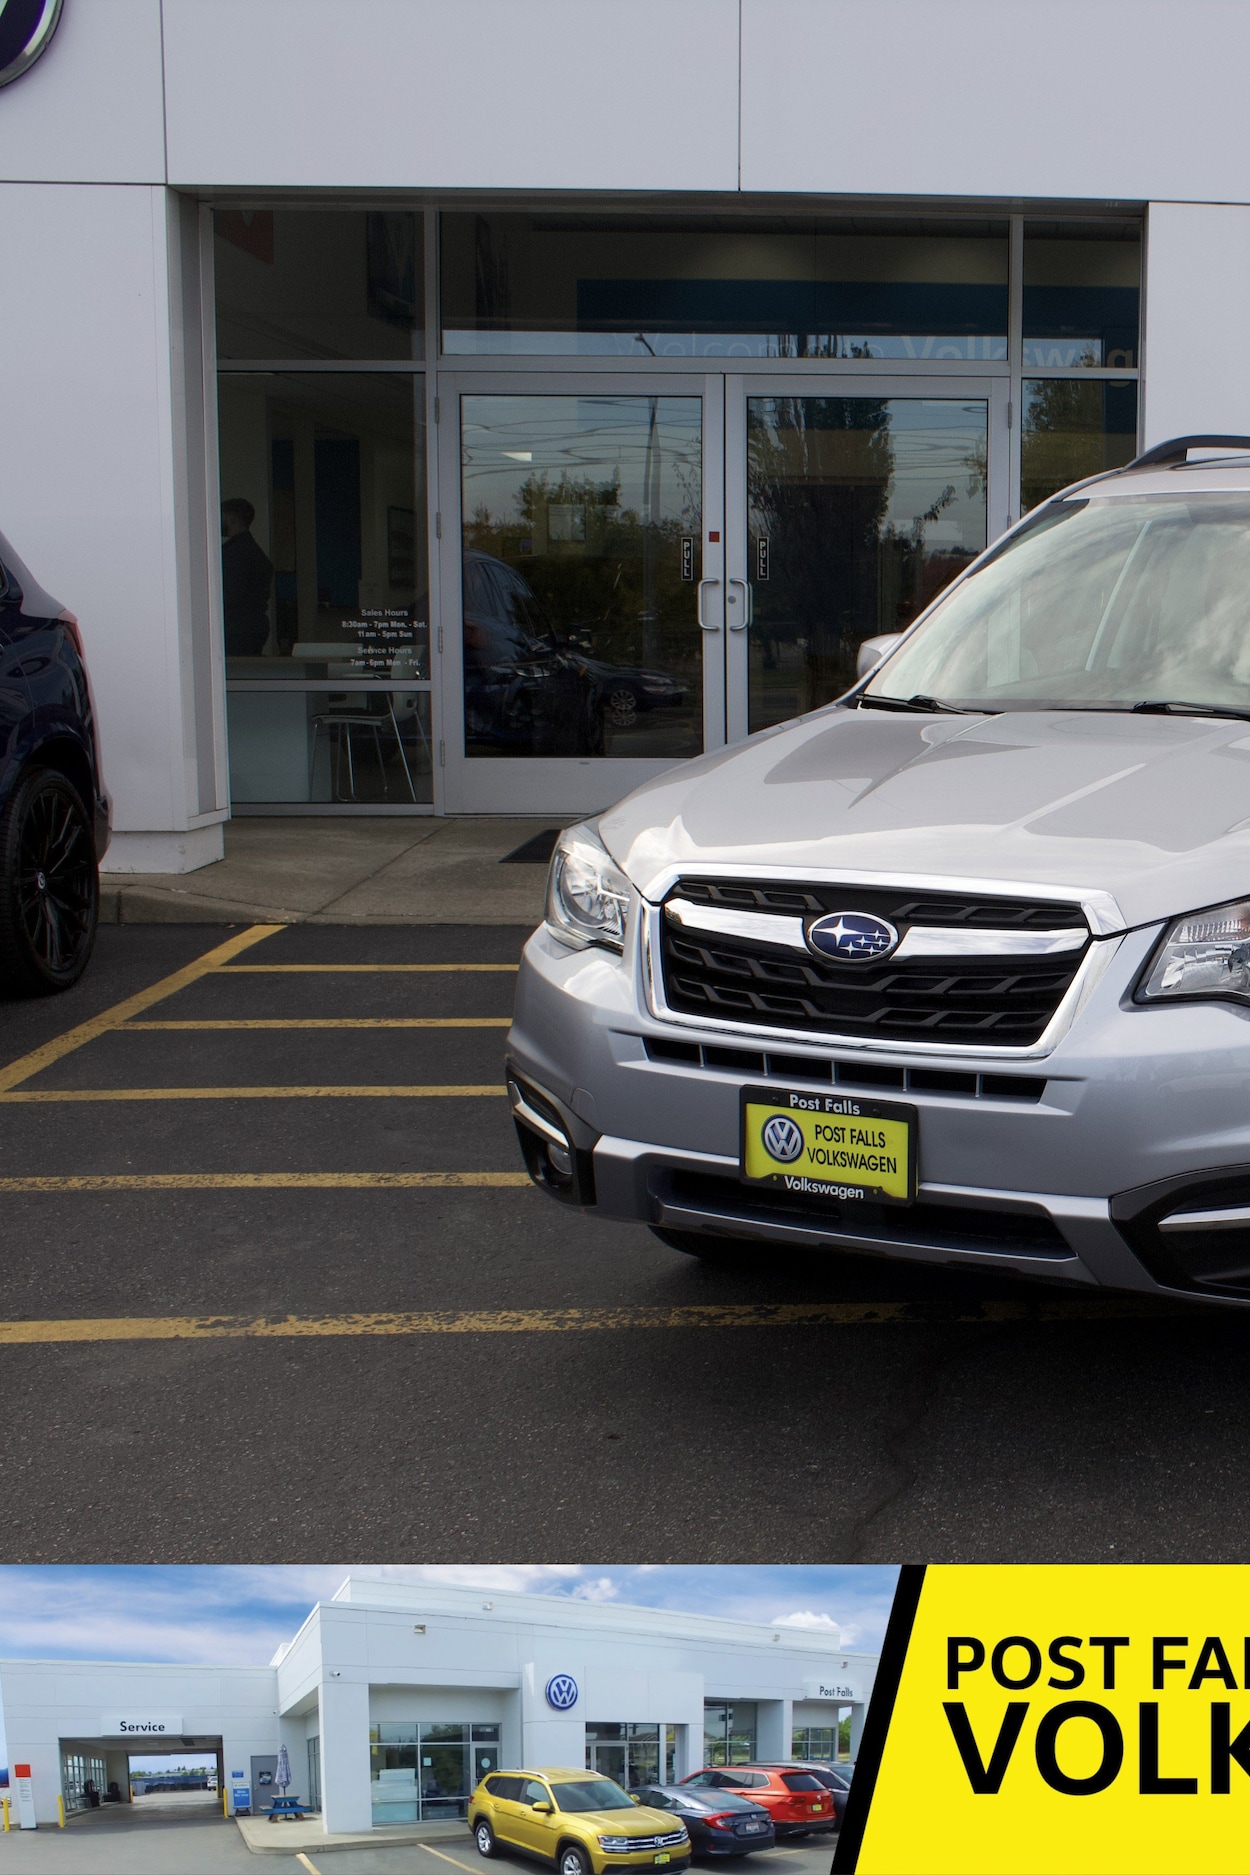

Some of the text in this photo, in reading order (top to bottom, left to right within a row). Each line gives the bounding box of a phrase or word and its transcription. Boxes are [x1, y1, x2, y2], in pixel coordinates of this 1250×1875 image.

[683, 541, 691, 577] PULL
[759, 541, 767, 576] PULL
[361, 609, 408, 617] Sales Hours
[373, 621, 389, 630] 7pm
[382, 631, 397, 639] 5pm
[358, 647, 412, 655] Service Hours
[789, 1094, 861, 1116] Post Falls
[815, 1124, 886, 1148] POST FALLS
[807, 1147, 897, 1174] VOLKSWAGEN
[784, 1175, 864, 1199] Volkswagen
